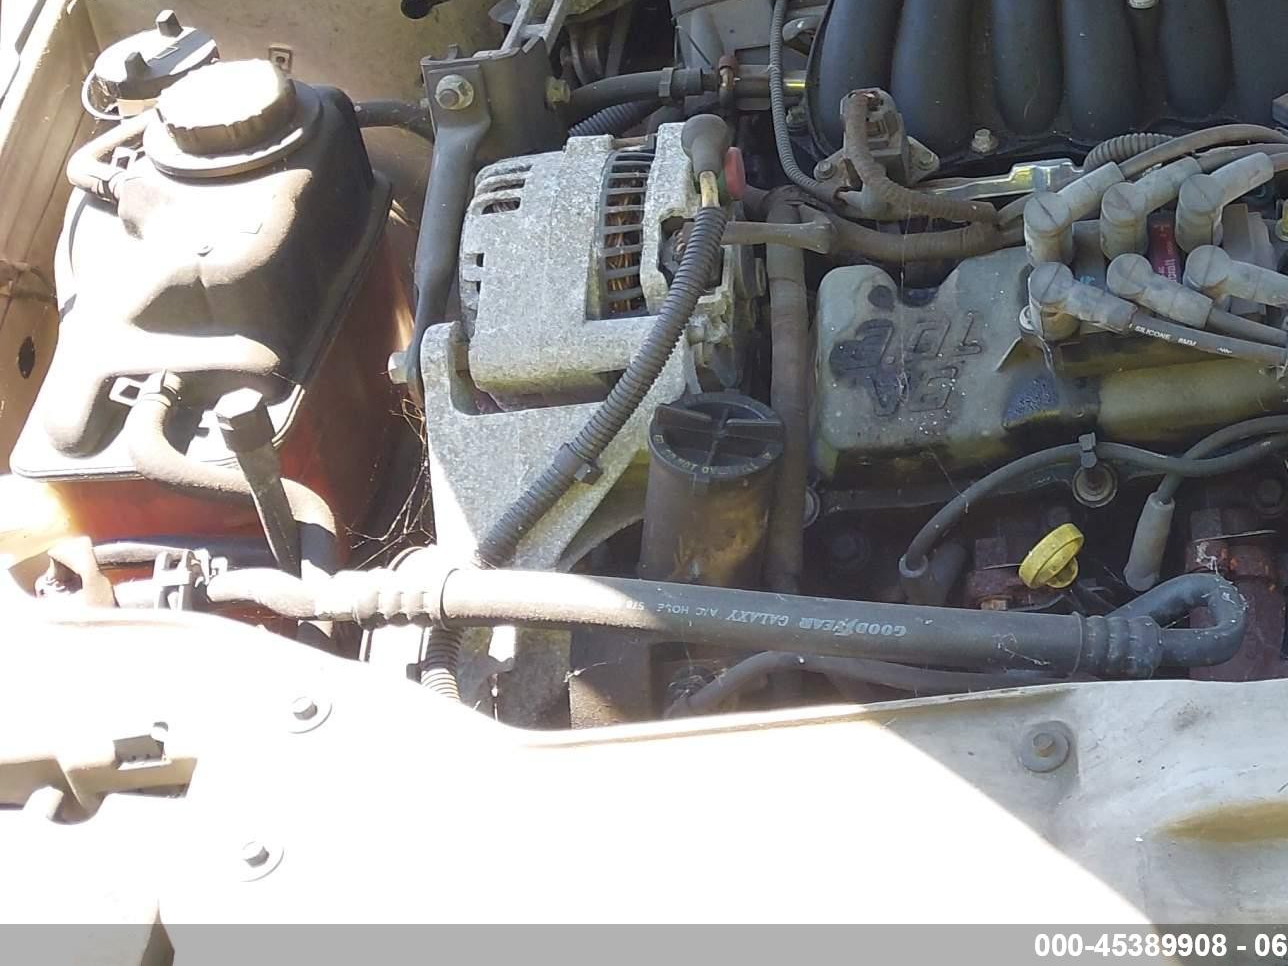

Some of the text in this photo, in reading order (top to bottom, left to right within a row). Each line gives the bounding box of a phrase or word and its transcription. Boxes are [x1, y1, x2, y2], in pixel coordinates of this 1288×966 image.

[656, 601, 690, 616] HOSE
[694, 605, 719, 619] A/C
[725, 608, 790, 628] GALAXY
[798, 616, 908, 638] GOODYEAR
